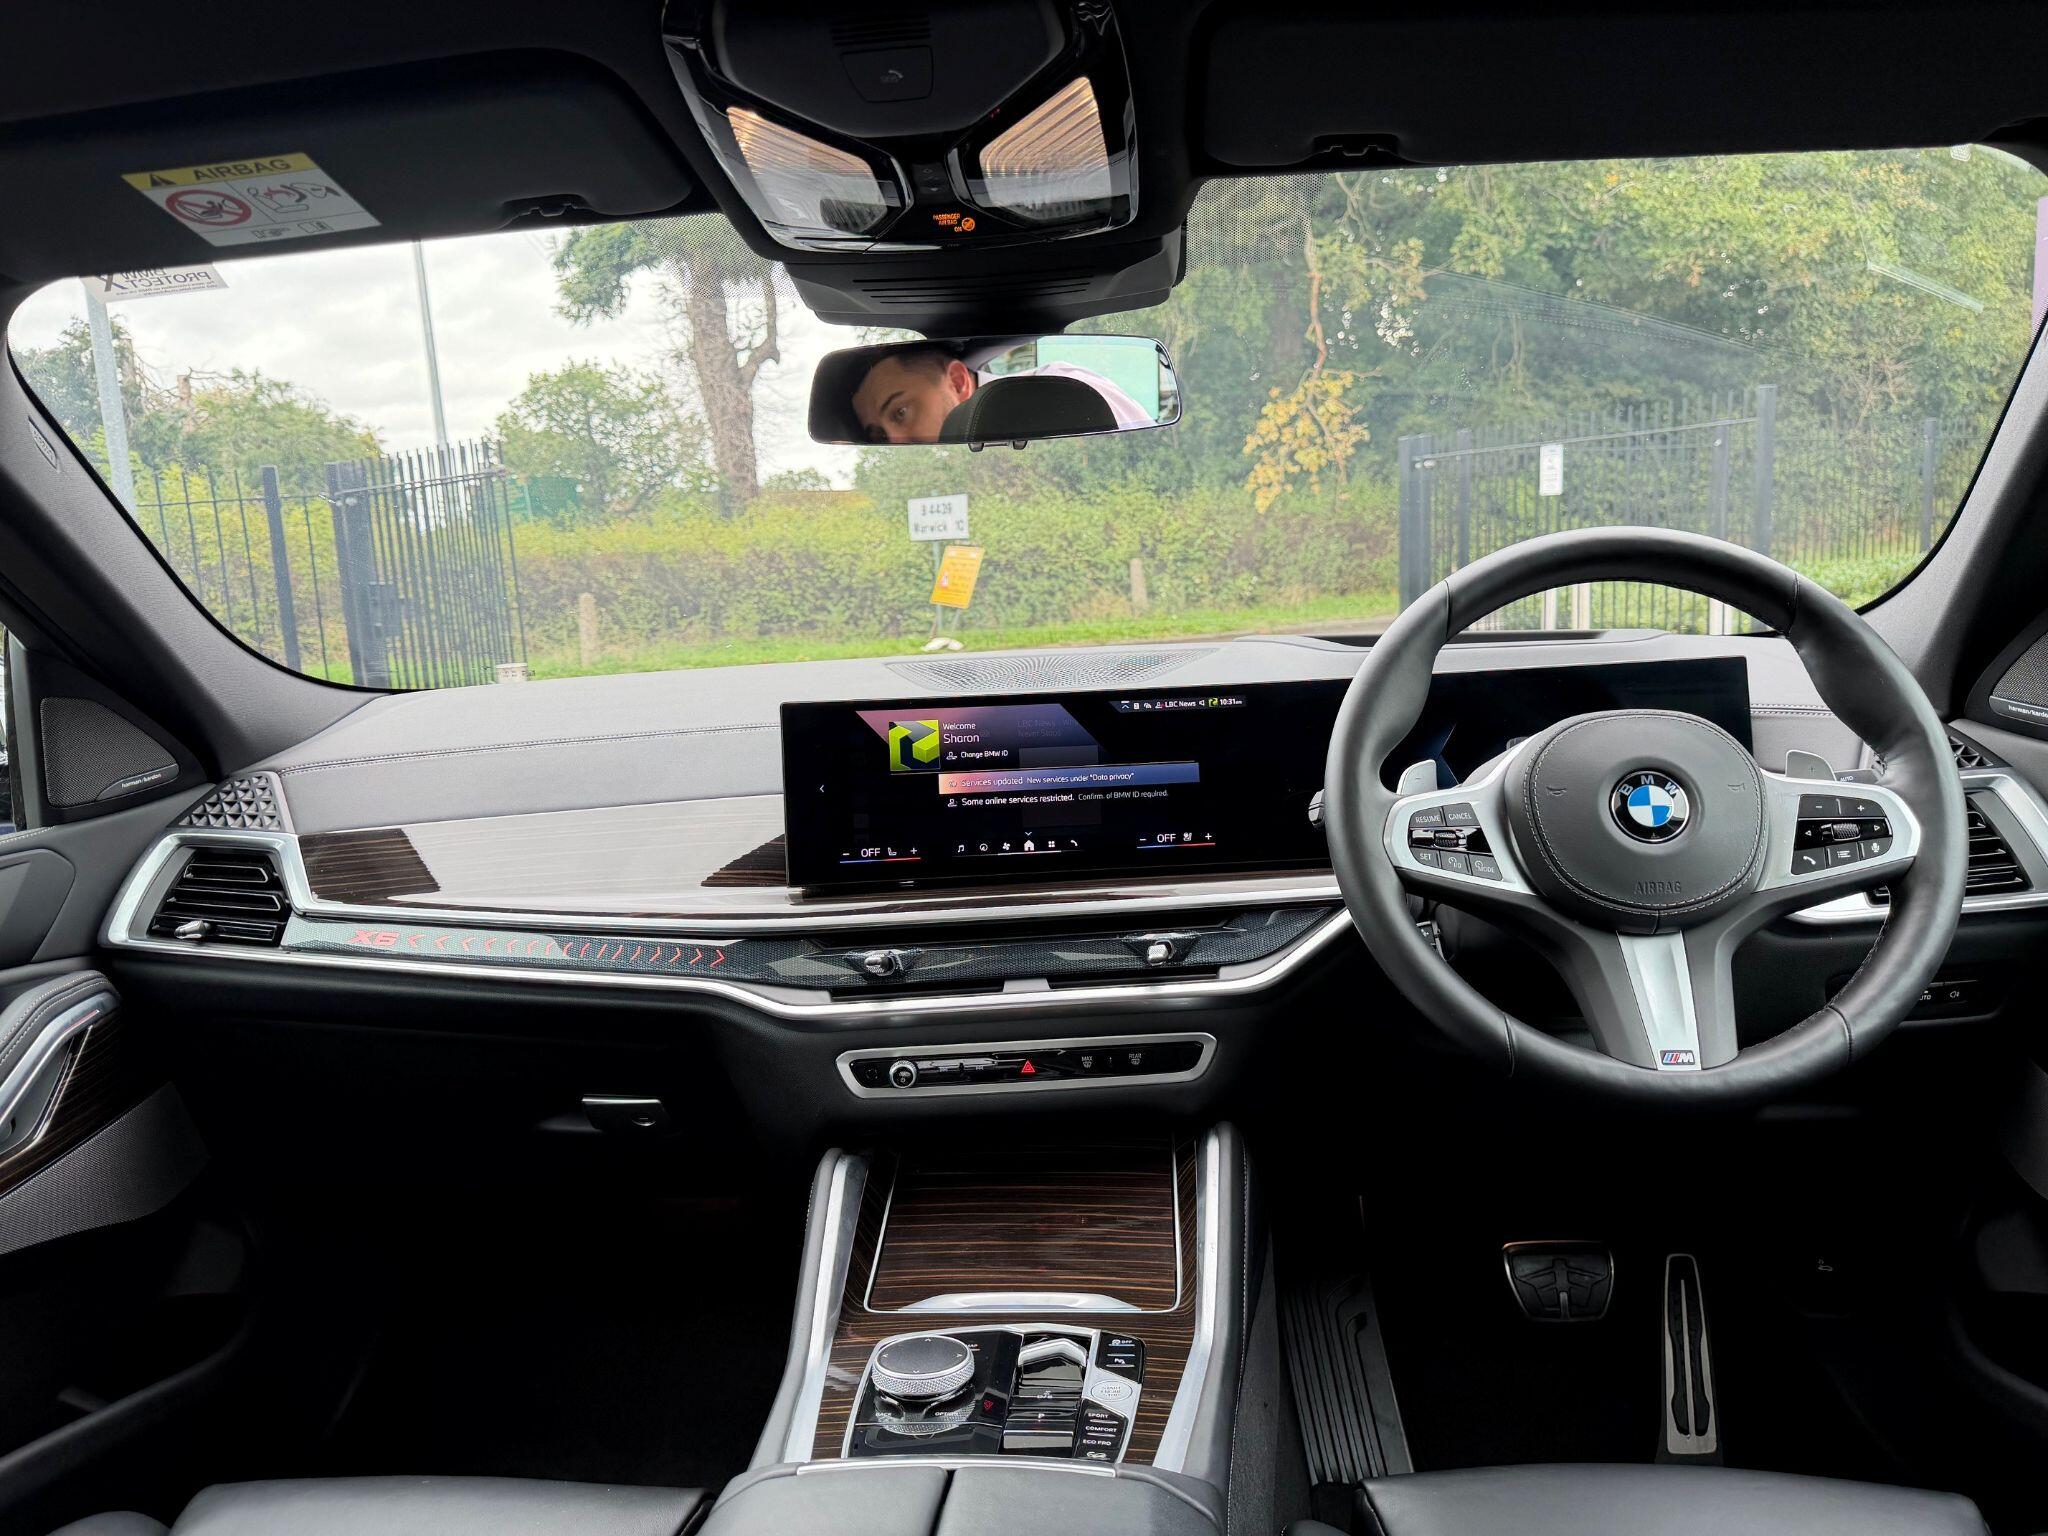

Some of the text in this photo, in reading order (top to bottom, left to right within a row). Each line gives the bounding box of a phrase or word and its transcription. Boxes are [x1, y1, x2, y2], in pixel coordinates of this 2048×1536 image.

[193, 158, 292, 181] AIRBAG
[1179, 700, 1196, 708] News
[2008, 704, 2048, 719] harman/kardo
[943, 722, 976, 730] Welcome
[943, 733, 980, 744] Sharon
[960, 751, 983, 759] Change
[961, 778, 991, 787] Services
[993, 777, 1023, 787] updated
[1042, 775, 1069, 783] services
[1070, 774, 1089, 782] under
[1619, 774, 1680, 797] BMW
[961, 798, 984, 806] Some
[985, 796, 1007, 805] online
[1008, 795, 1038, 804] services
[1039, 793, 1075, 803] restricted.
[1132, 790, 1140, 798] ID
[1415, 814, 1441, 823] RESUME
[1448, 812, 1472, 821] CANCEL
[1157, 833, 1176, 843] OFF
[861, 848, 881, 858] OFF
[1420, 853, 1432, 861] SET
[1633, 881, 1682, 895] AIRBAG
[346, 930, 400, 946] X6
[1085, 1425, 1118, 1433] COMFORT
